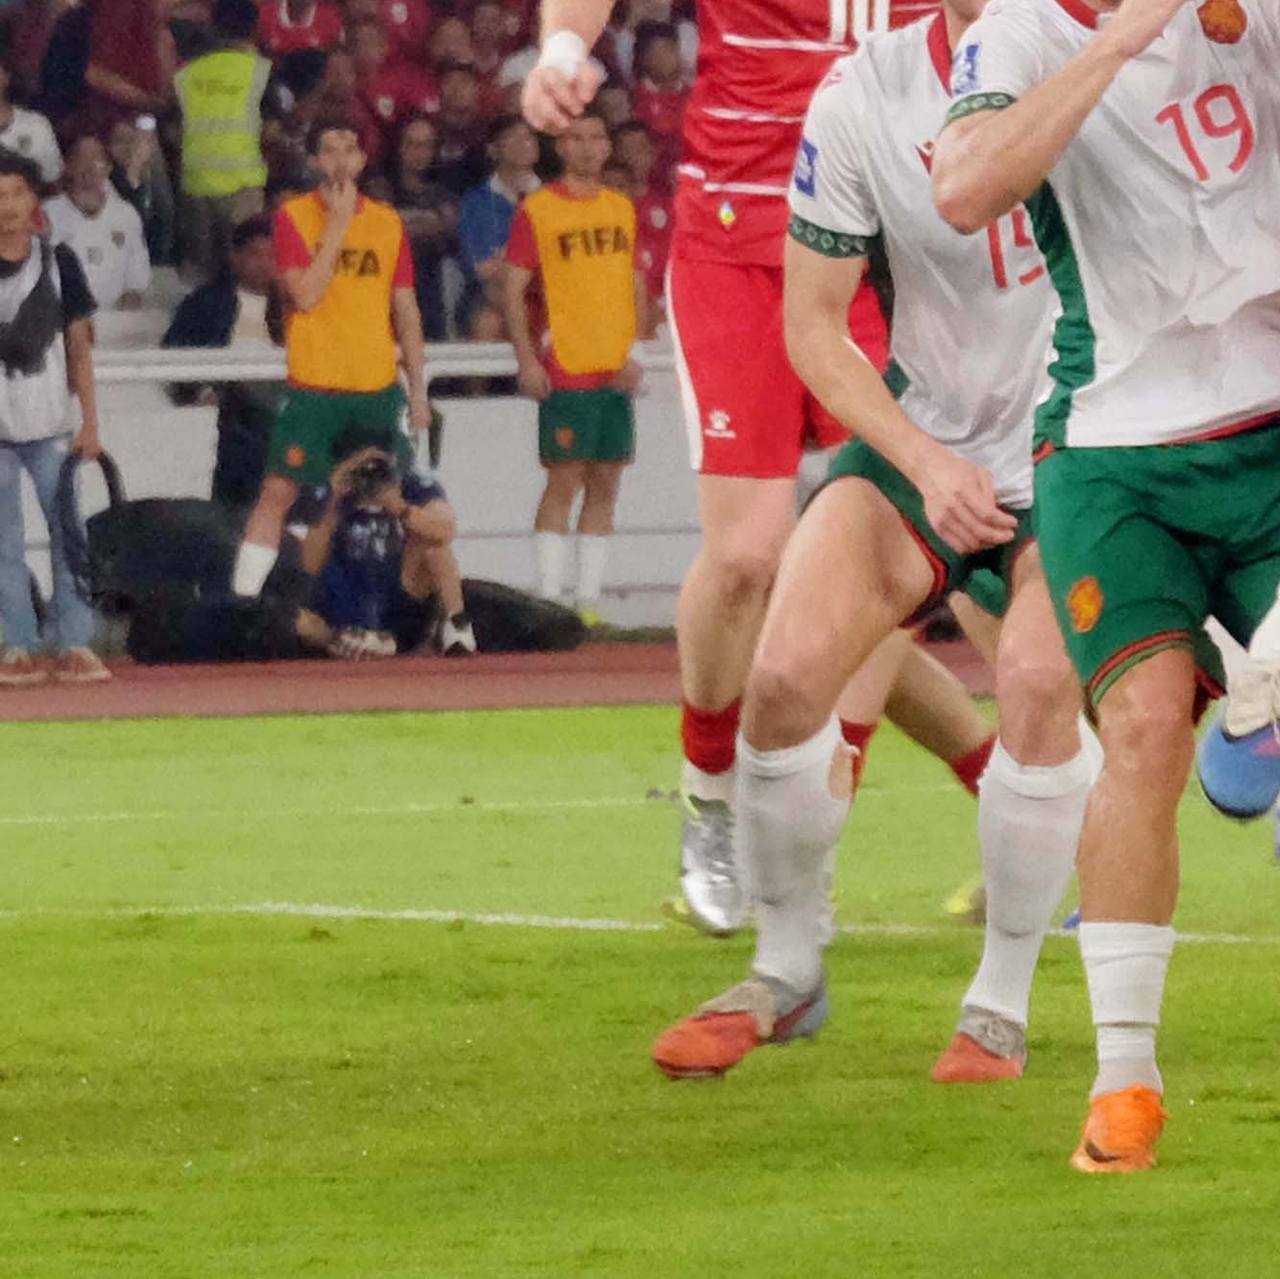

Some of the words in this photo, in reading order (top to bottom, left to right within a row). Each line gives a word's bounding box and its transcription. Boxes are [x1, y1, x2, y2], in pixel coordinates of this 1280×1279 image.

[1155, 83, 1255, 182] 19
[315, 242, 382, 277] FA
[557, 226, 630, 261] FIFA
